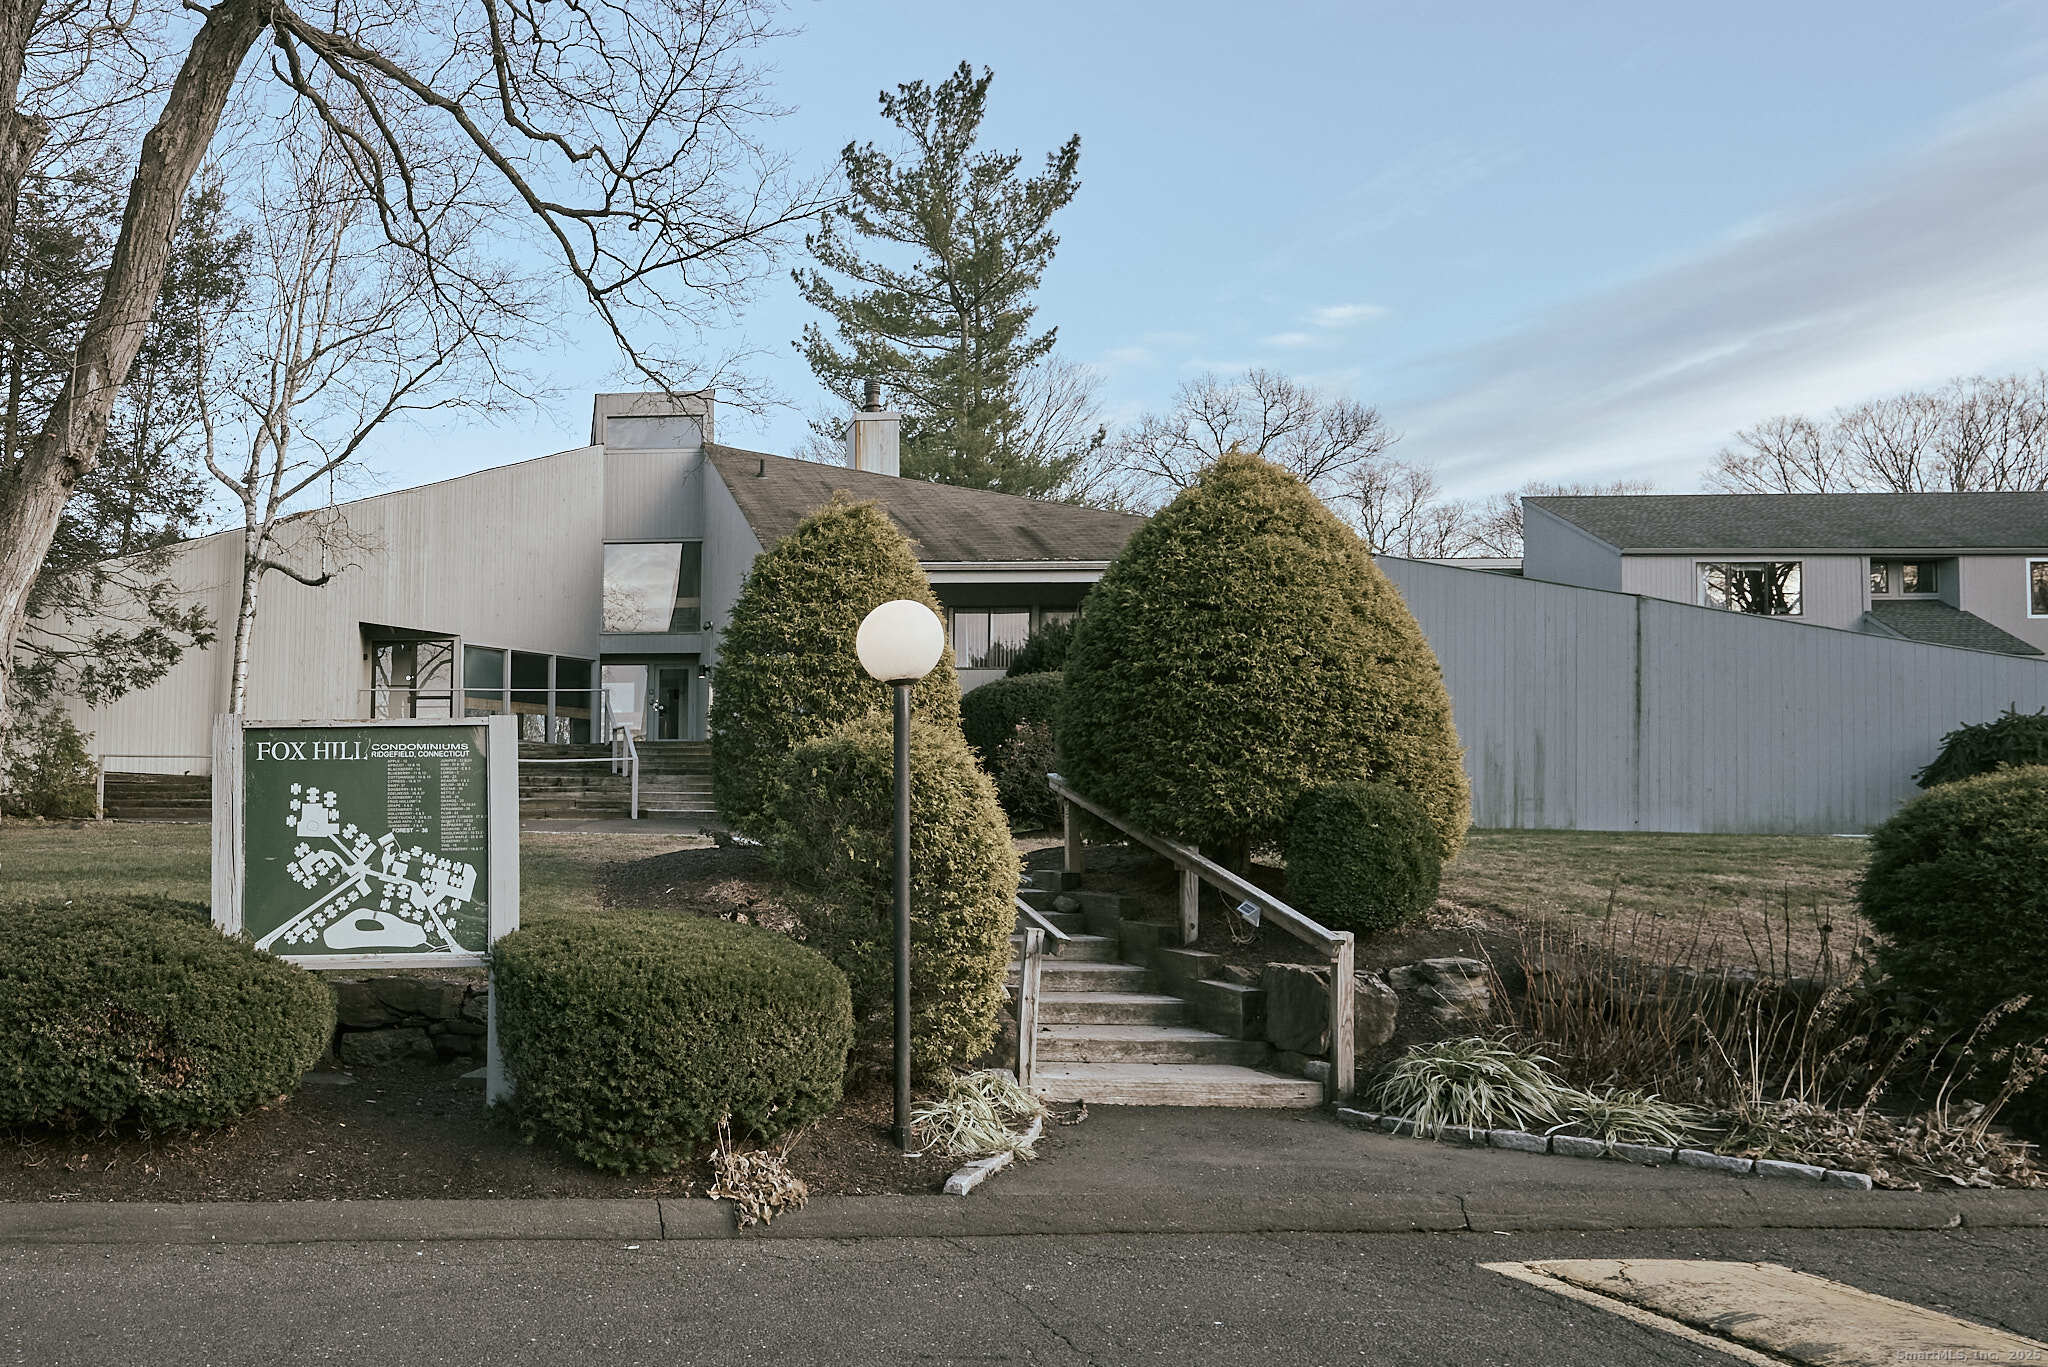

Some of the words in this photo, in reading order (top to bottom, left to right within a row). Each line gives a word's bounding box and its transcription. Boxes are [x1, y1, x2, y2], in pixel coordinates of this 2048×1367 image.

[256, 741, 307, 760] FOX
[312, 741, 368, 760] HILL
[371, 750, 416, 758] RIDGEFIELD,
[418, 750, 470, 758] CONNECTICUT
